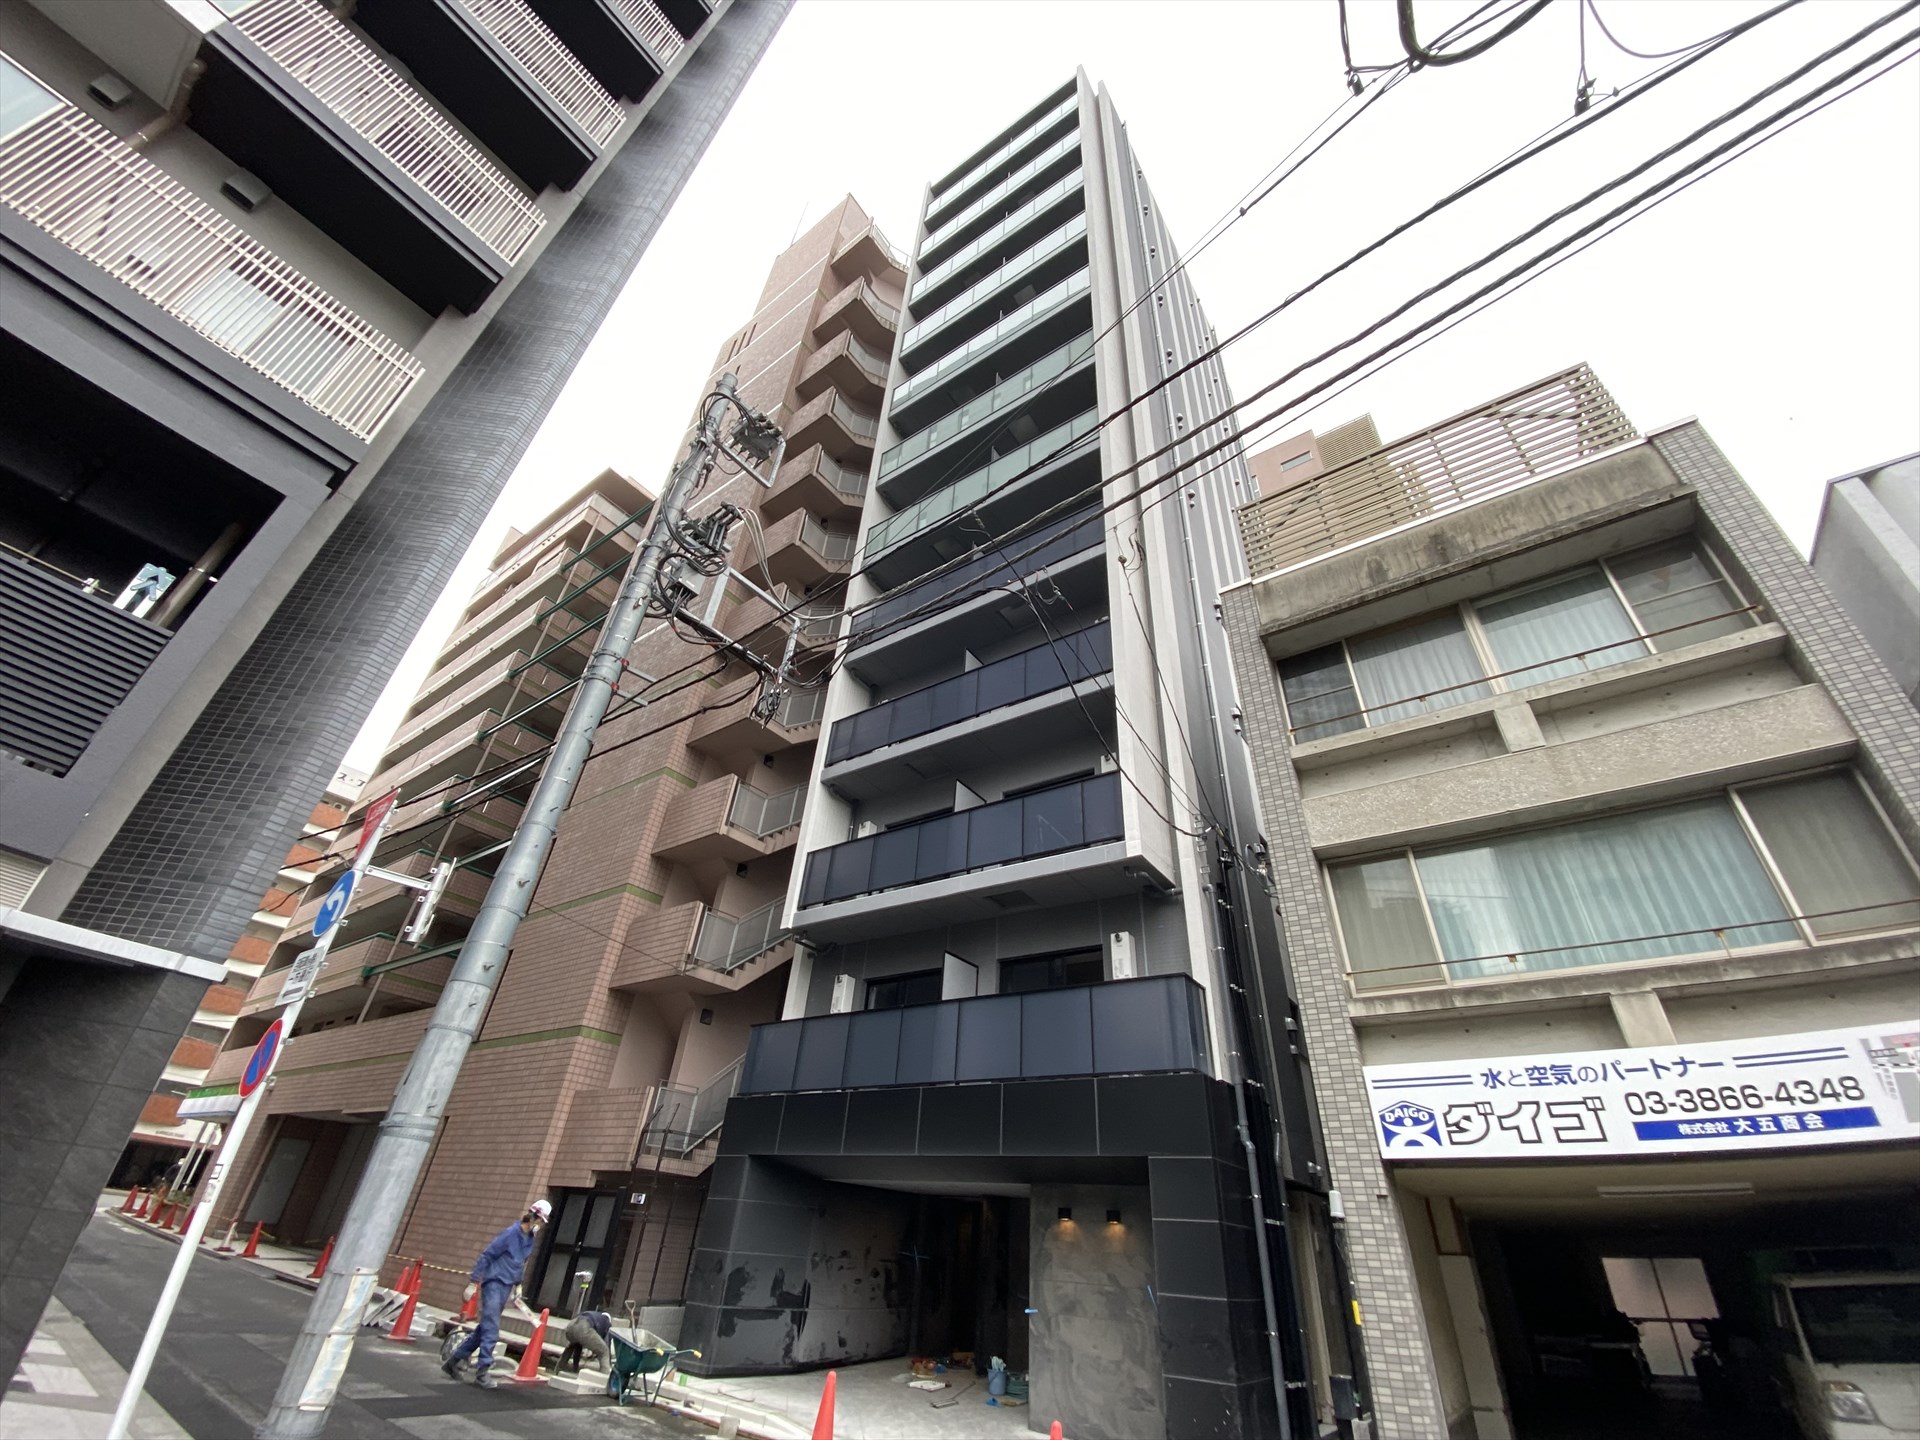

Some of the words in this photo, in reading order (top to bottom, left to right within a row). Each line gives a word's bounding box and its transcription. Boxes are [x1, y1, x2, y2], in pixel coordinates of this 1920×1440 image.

[1483, 1056, 1723, 1089] 水と空気のパートナー
[1624, 1076, 1865, 1115] 03-3866-4348
[1384, 1107, 1430, 1123] DAIGO
[1442, 1096, 1608, 1146] ダイゴ
